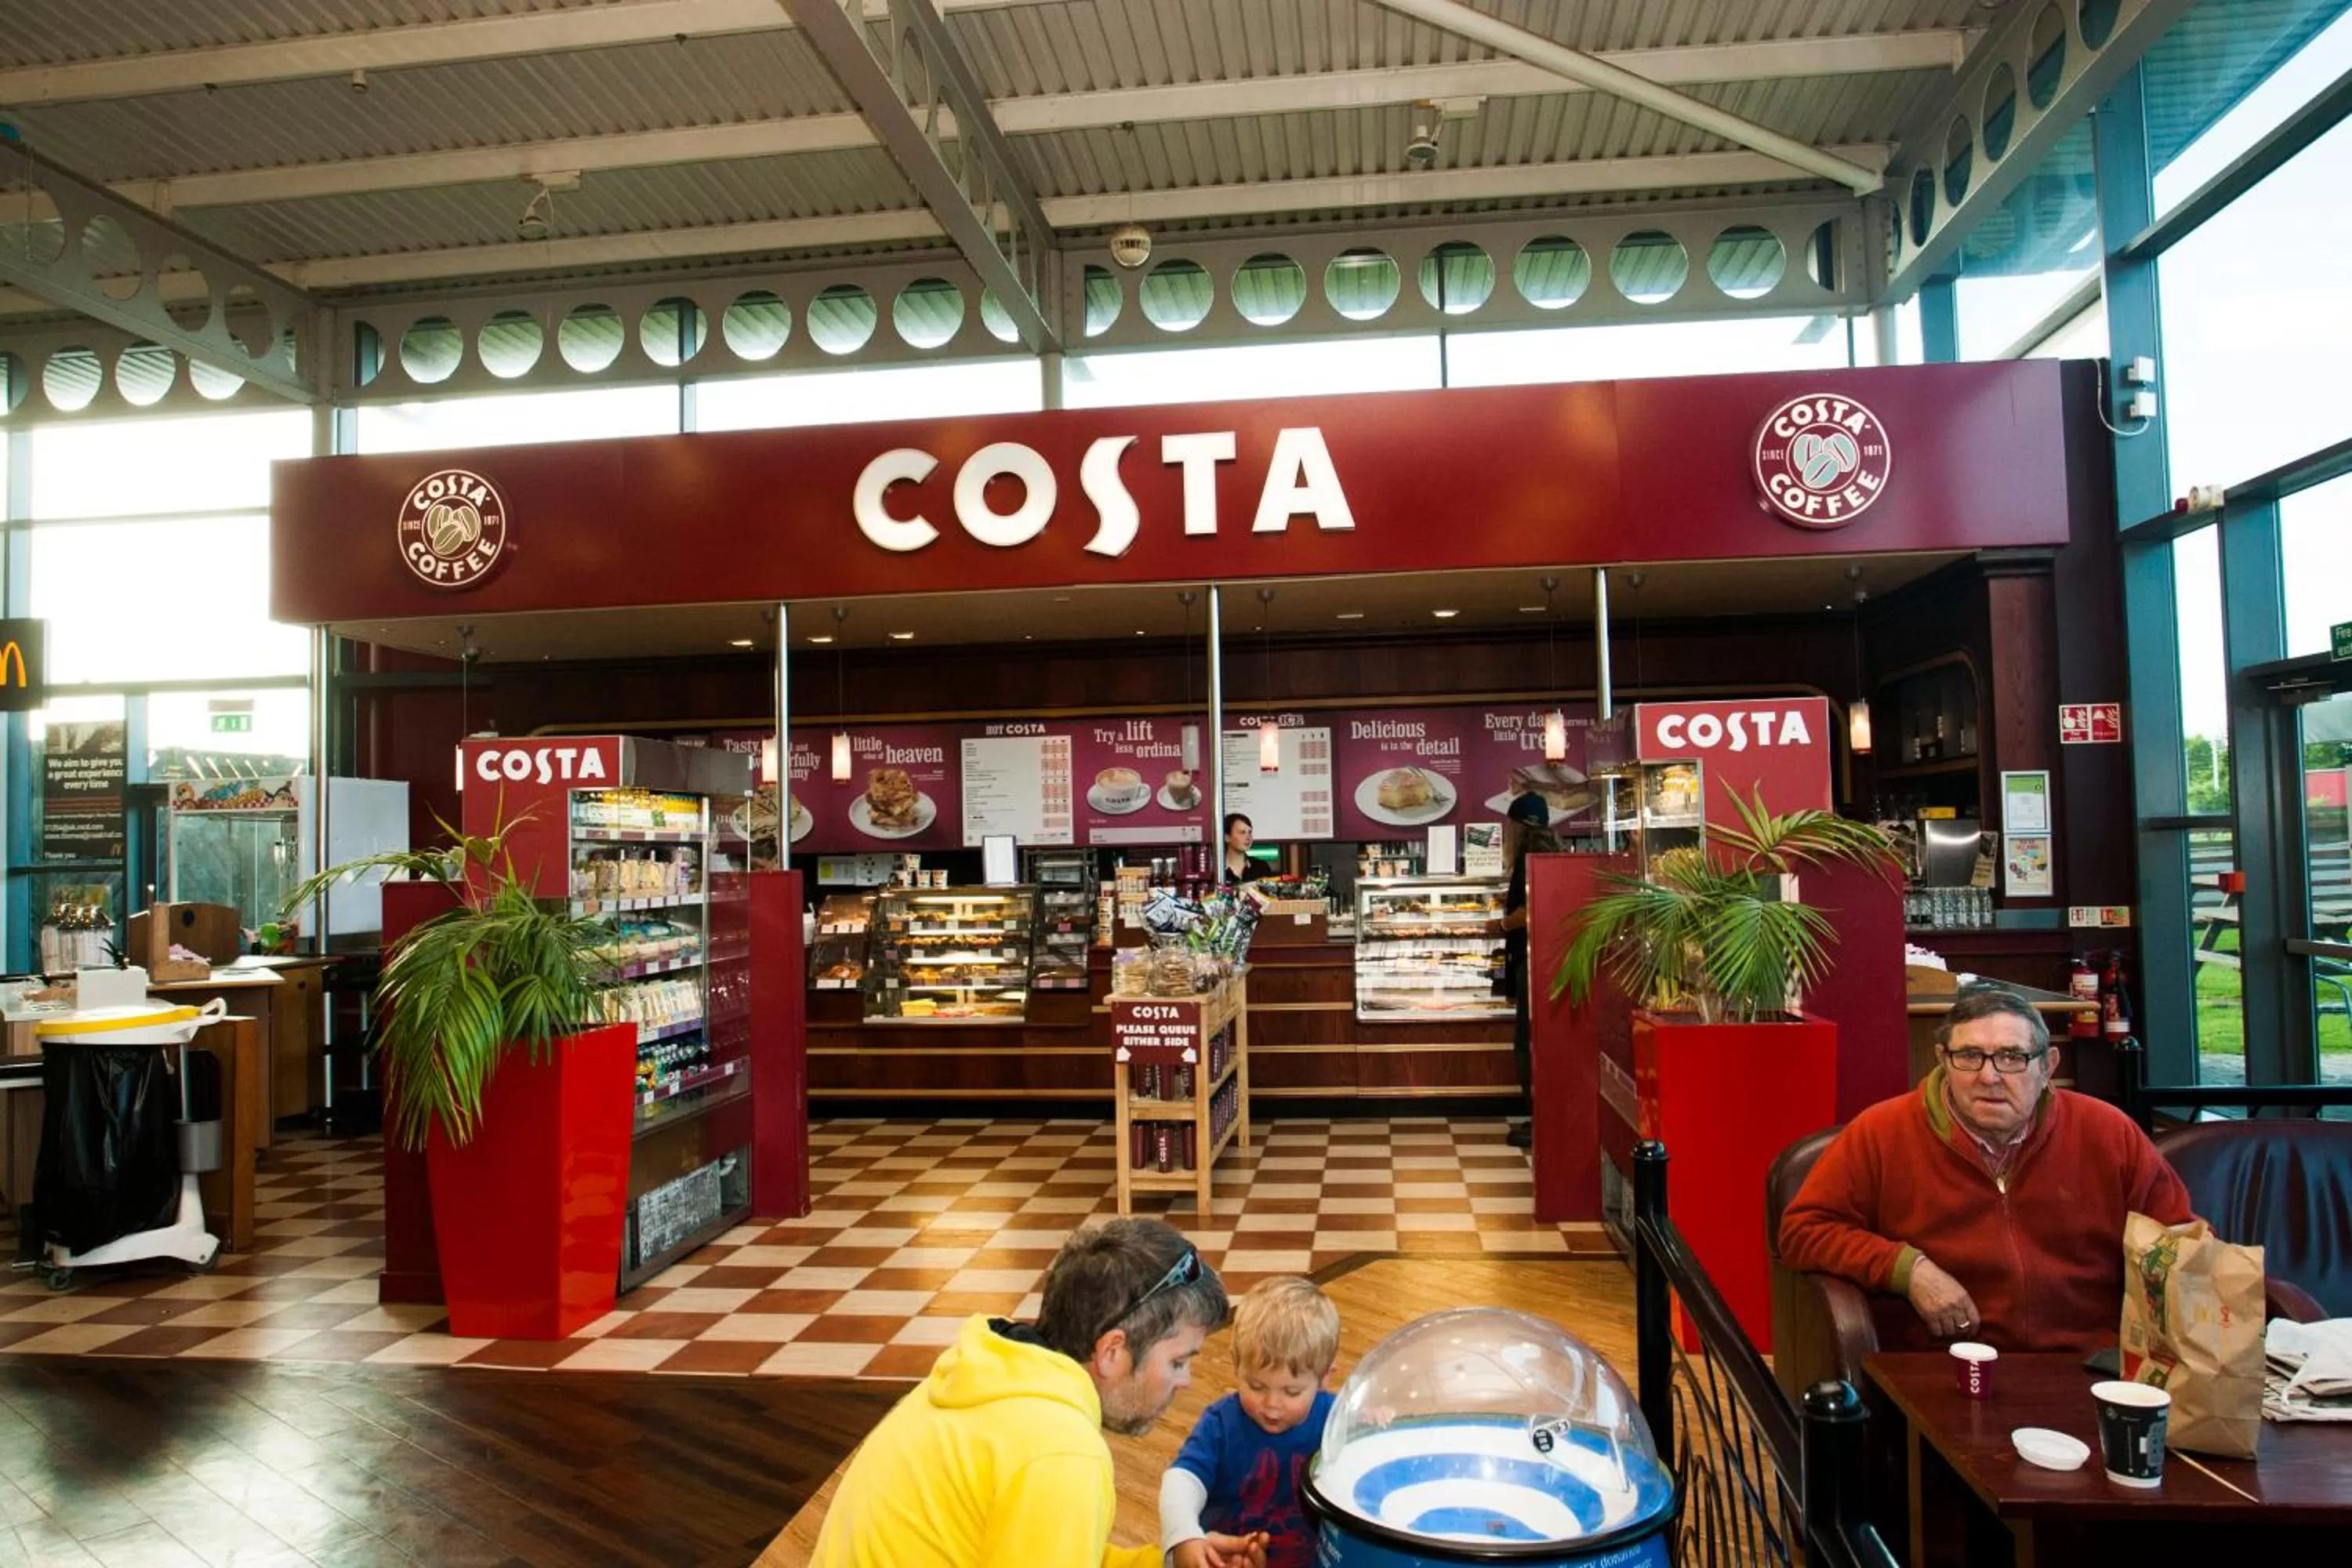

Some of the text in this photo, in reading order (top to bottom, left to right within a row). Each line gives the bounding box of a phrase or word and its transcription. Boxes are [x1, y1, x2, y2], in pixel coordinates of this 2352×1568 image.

[1774, 400, 1866, 437] COSTA
[1762, 449, 1784, 460] SINCE
[413, 475, 488, 510] COSTA
[853, 426, 1356, 557] COSTA
[1770, 470, 1880, 517] COFFEE
[408, 539, 496, 579] COFFEE
[1006, 724, 1046, 735] COSTA
[1351, 720, 1426, 739] Delicious
[1484, 713, 1523, 731] Every
[1528, 711, 1544, 728] da
[1094, 728, 1116, 744] Try
[1126, 720, 1154, 741] lift
[1494, 730, 1517, 742] little
[1657, 711, 1811, 752] COSTA
[853, 736, 883, 752] little
[1115, 743, 1181, 758] less ordina
[1417, 737, 1460, 756] detail
[885, 744, 943, 764] heaven
[476, 746, 606, 785] COSTA
[1131, 1006, 1180, 1020] COSTA
[1116, 1024, 1197, 1034] PLEASE QUEUE
[1123, 1036, 1189, 1047] EITHER SIDE
